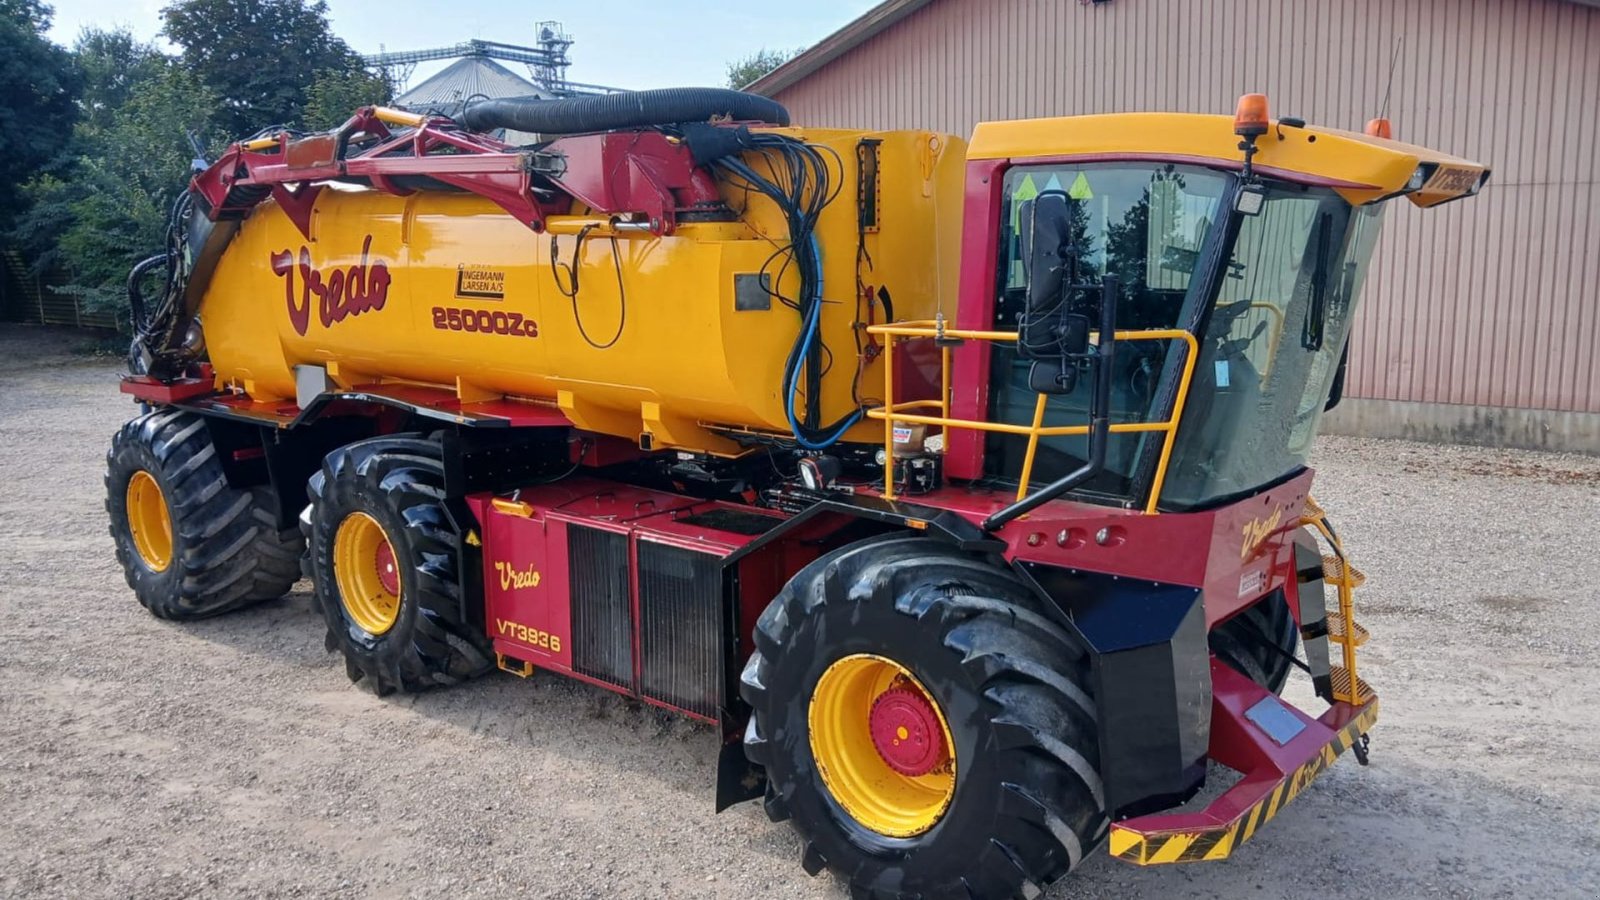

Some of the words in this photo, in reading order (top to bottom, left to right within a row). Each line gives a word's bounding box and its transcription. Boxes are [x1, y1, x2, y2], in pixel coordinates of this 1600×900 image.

[270, 233, 391, 337] Vredo
[463, 270, 505, 282] INGEMANN
[463, 281, 489, 291] LARSEN
[490, 282, 504, 292] A/S
[432, 306, 538, 338] 25000Zc
[494, 560, 541, 591] Vredo
[496, 618, 561, 653] VT3936
